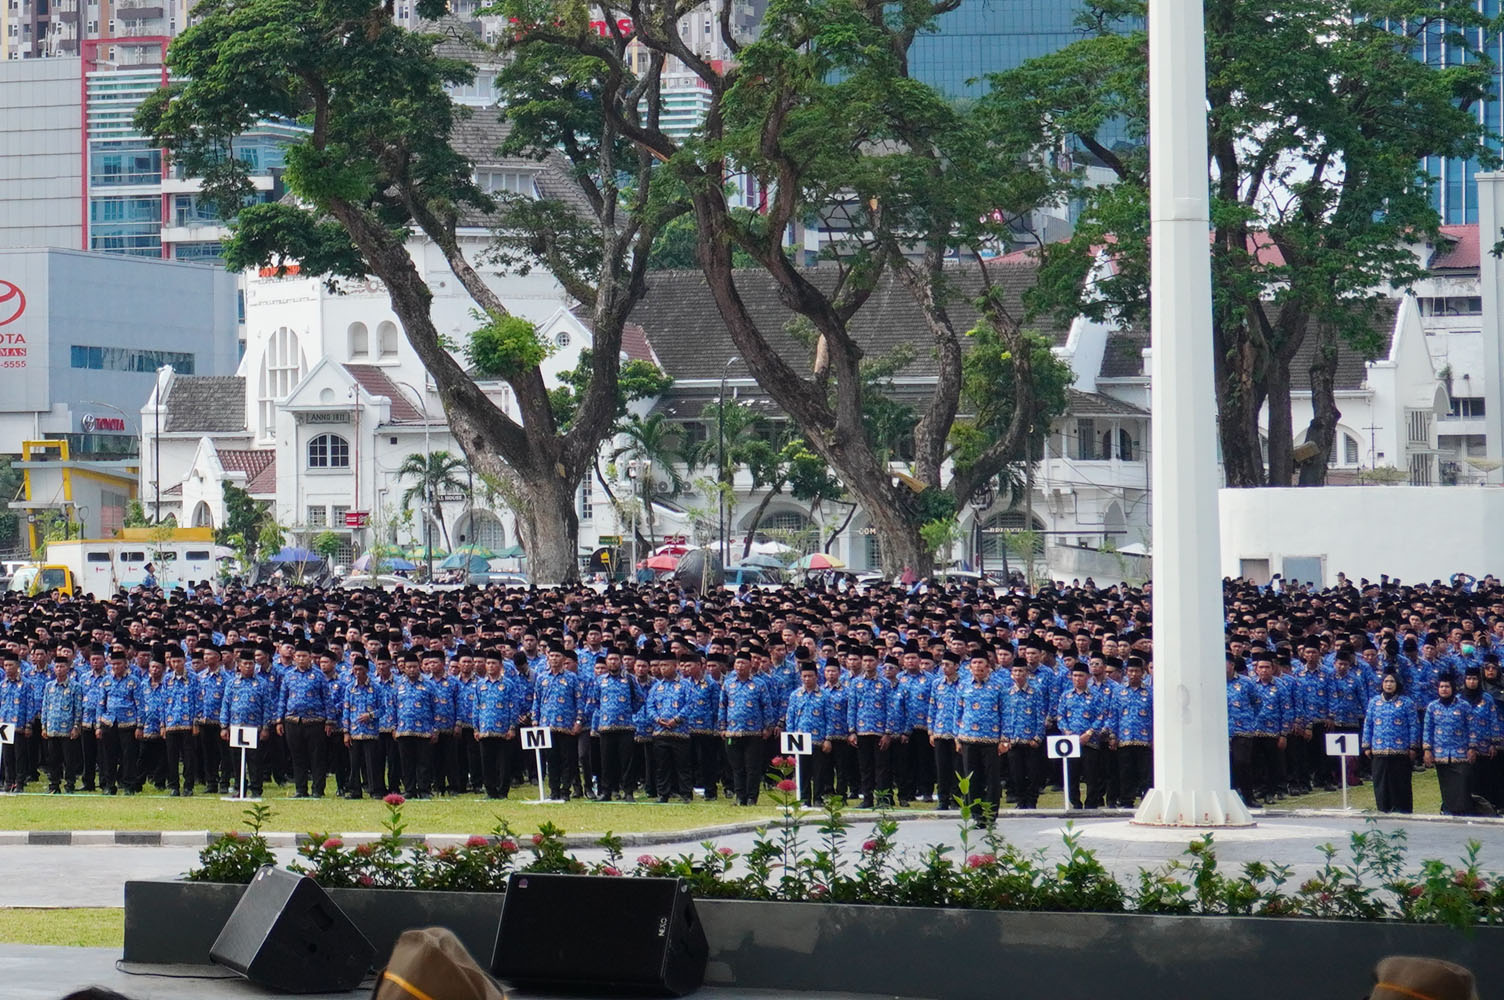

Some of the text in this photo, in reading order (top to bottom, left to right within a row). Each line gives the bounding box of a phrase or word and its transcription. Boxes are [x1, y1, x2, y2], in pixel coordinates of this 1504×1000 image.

[95, 417, 125, 431] TOYOTA
[310, 412, 331, 421] ANNO
[237, 728, 250, 746] L
[526, 729, 546, 748] M
[787, 733, 804, 752] N
[1334, 734, 1347, 754] 1
[1055, 738, 1073, 757] O
